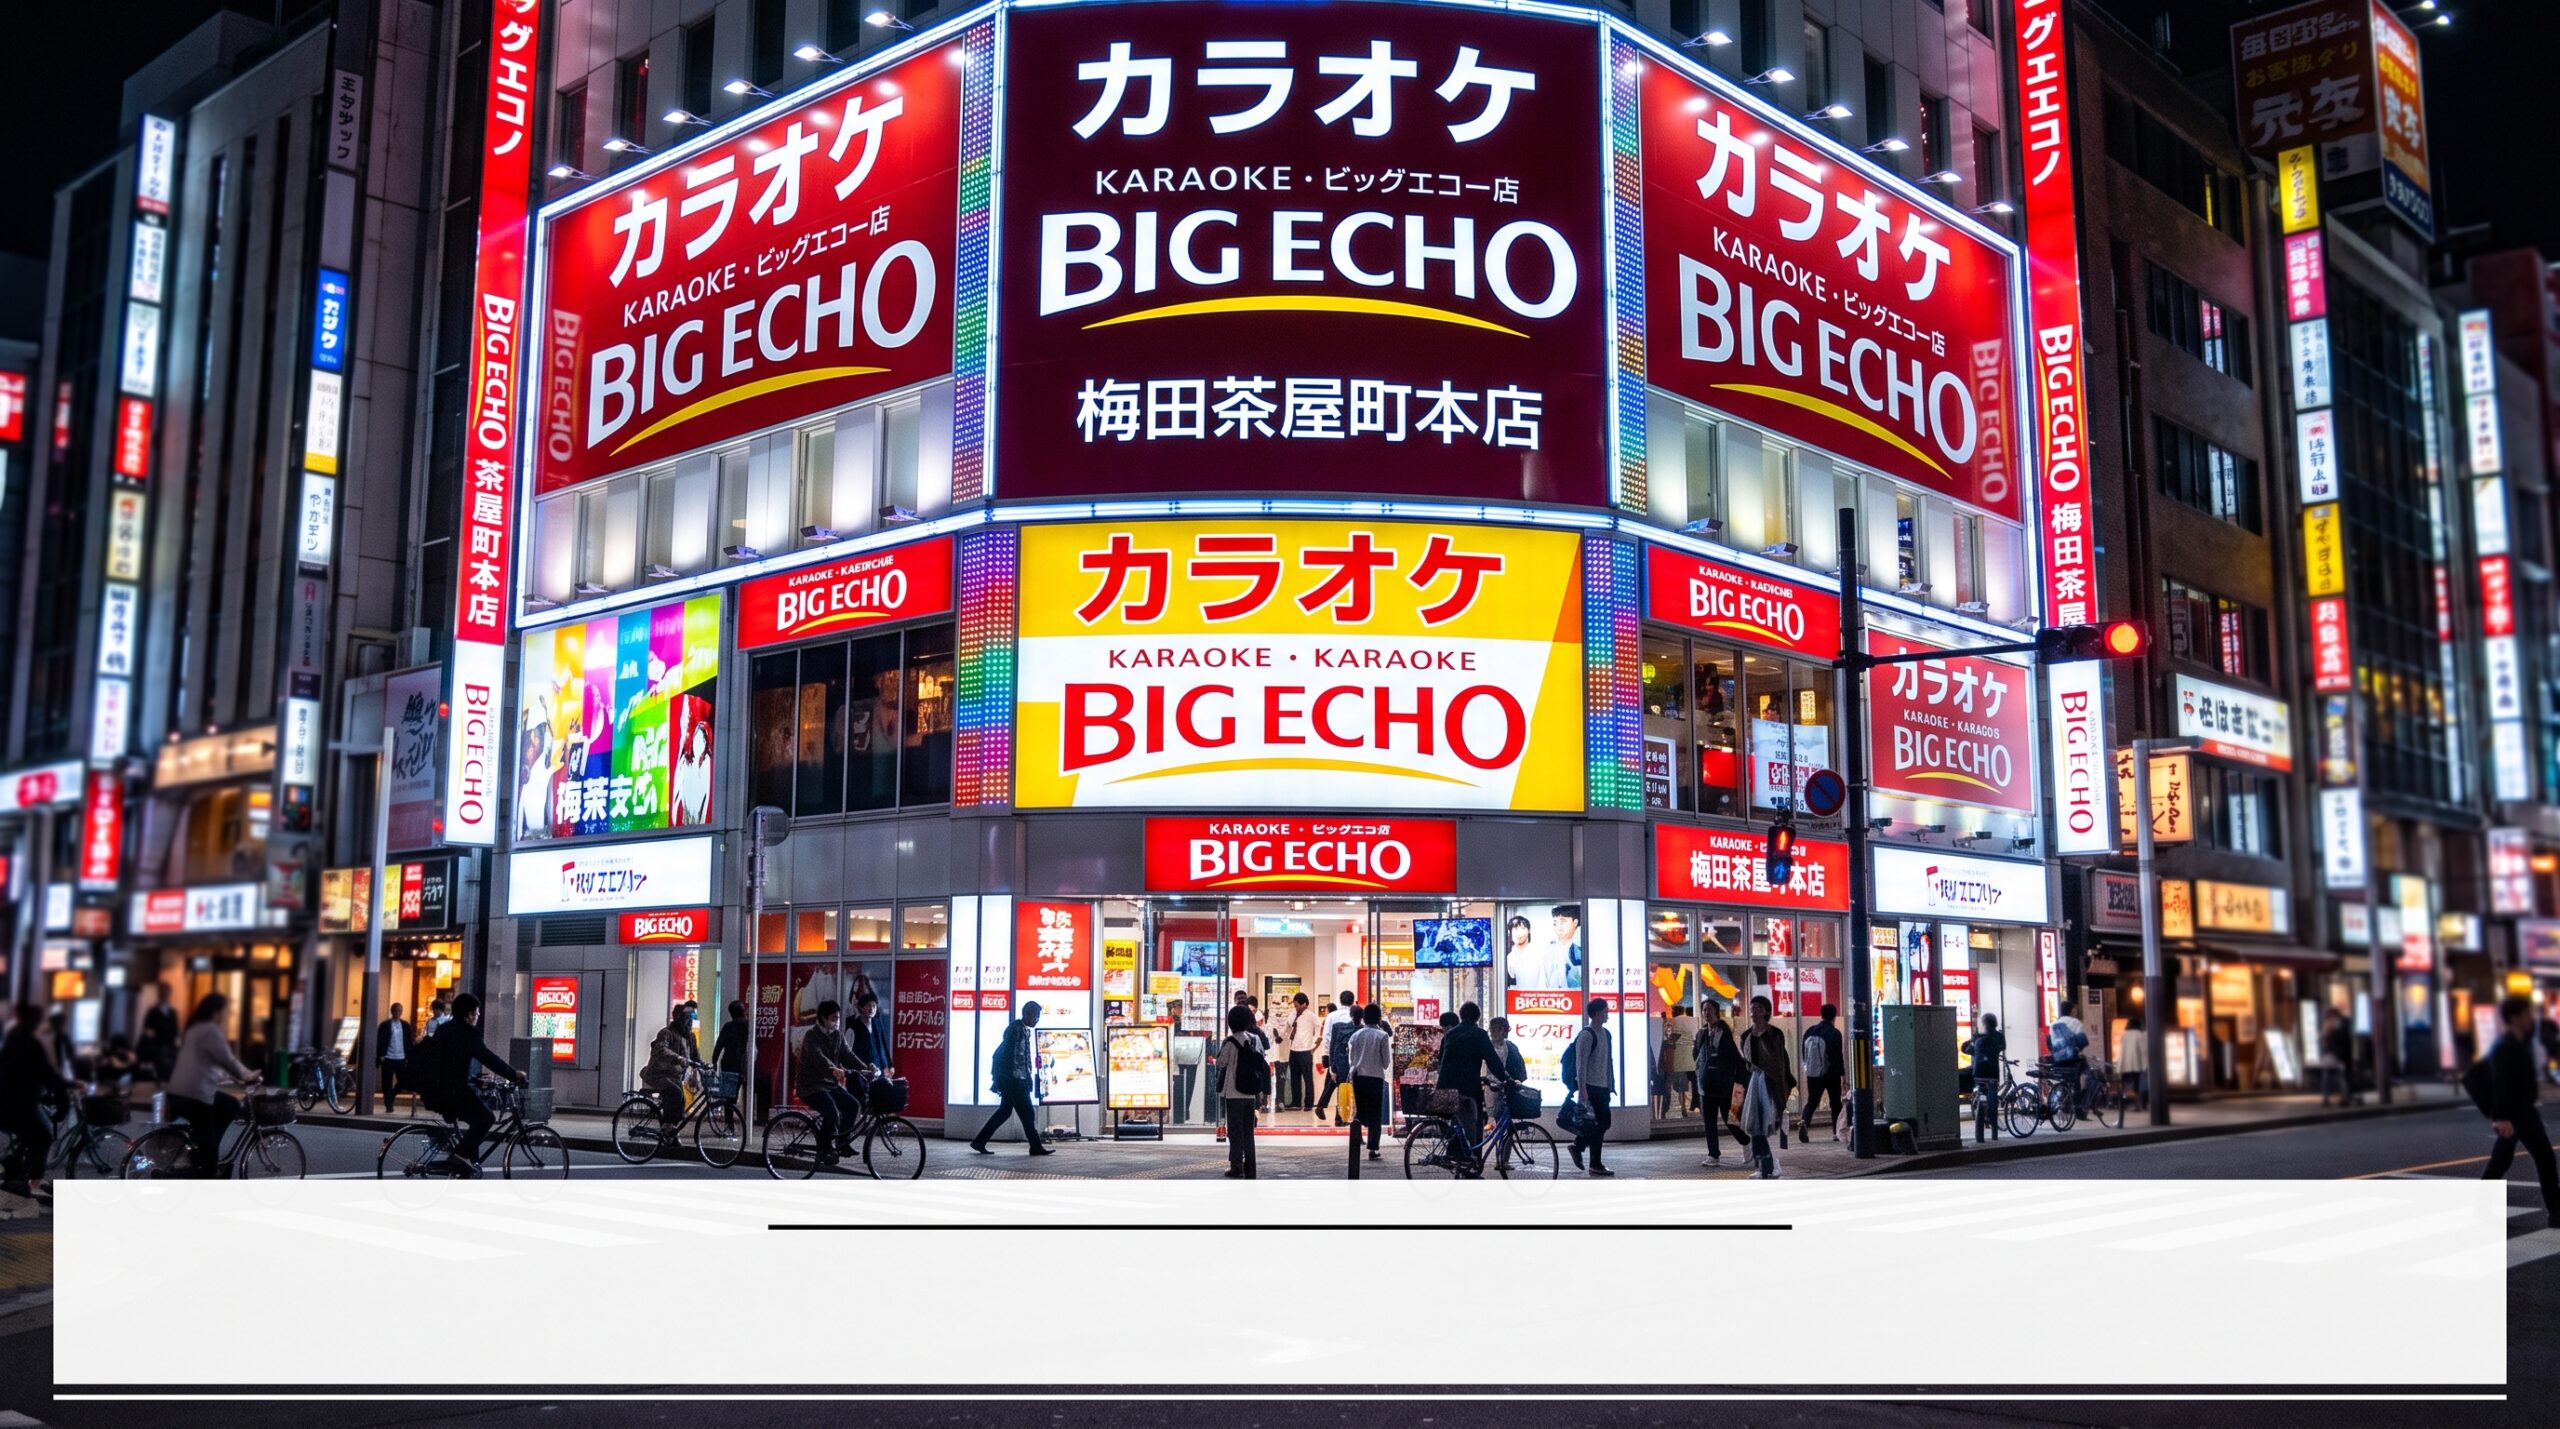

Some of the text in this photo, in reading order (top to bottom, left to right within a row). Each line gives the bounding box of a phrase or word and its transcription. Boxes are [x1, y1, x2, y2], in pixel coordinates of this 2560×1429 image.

[1073, 40, 1536, 143] カラオケ
[609, 96, 903, 287] カラオケ
[1097, 166, 1292, 195] KARAOKE
[1325, 166, 1520, 204] ビッグエコー店
[1697, 110, 1950, 301] カラオケ
[623, 263, 737, 327] KARAOKE
[757, 205, 891, 276] ビッグエコー店
[1040, 209, 1579, 319] BIG ECHO
[1713, 226, 1827, 303] KARAOKE
[1843, 288, 1945, 357] ビッグエコー店
[587, 240, 936, 449] BIG ECHO
[1679, 253, 1977, 464] BIG ECHO
[2039, 324, 2073, 390] BIG
[1077, 376, 1542, 450] 梅田茶屋町本店
[2049, 395, 2080, 492] ECHO
[467, 292, 516, 627] BIG ECHO 茶屋町本店
[777, 569, 907, 631] BIG ECHO
[1078, 533, 1504, 625] カラオケ
[1689, 577, 1805, 641] BIG ECHO
[1109, 648, 1272, 668] KARAOKE
[1315, 648, 1477, 671] KARAOKE
[1891, 646, 2008, 718] カラオケ
[459, 683, 490, 825] BIG ECHO
[1063, 683, 1527, 771] BIG ECHO
[1894, 725, 2012, 788] BIG ECHO
[2061, 690, 2094, 833] BIG ECHO
[1190, 839, 1411, 881] BIG ECHO
[1209, 823, 1290, 835] KARAOKE
[1710, 836, 1752, 852] KARAOKE
[1690, 850, 1825, 898] 梅田茶屋本店
[634, 916, 693, 938] BIG ECHO
